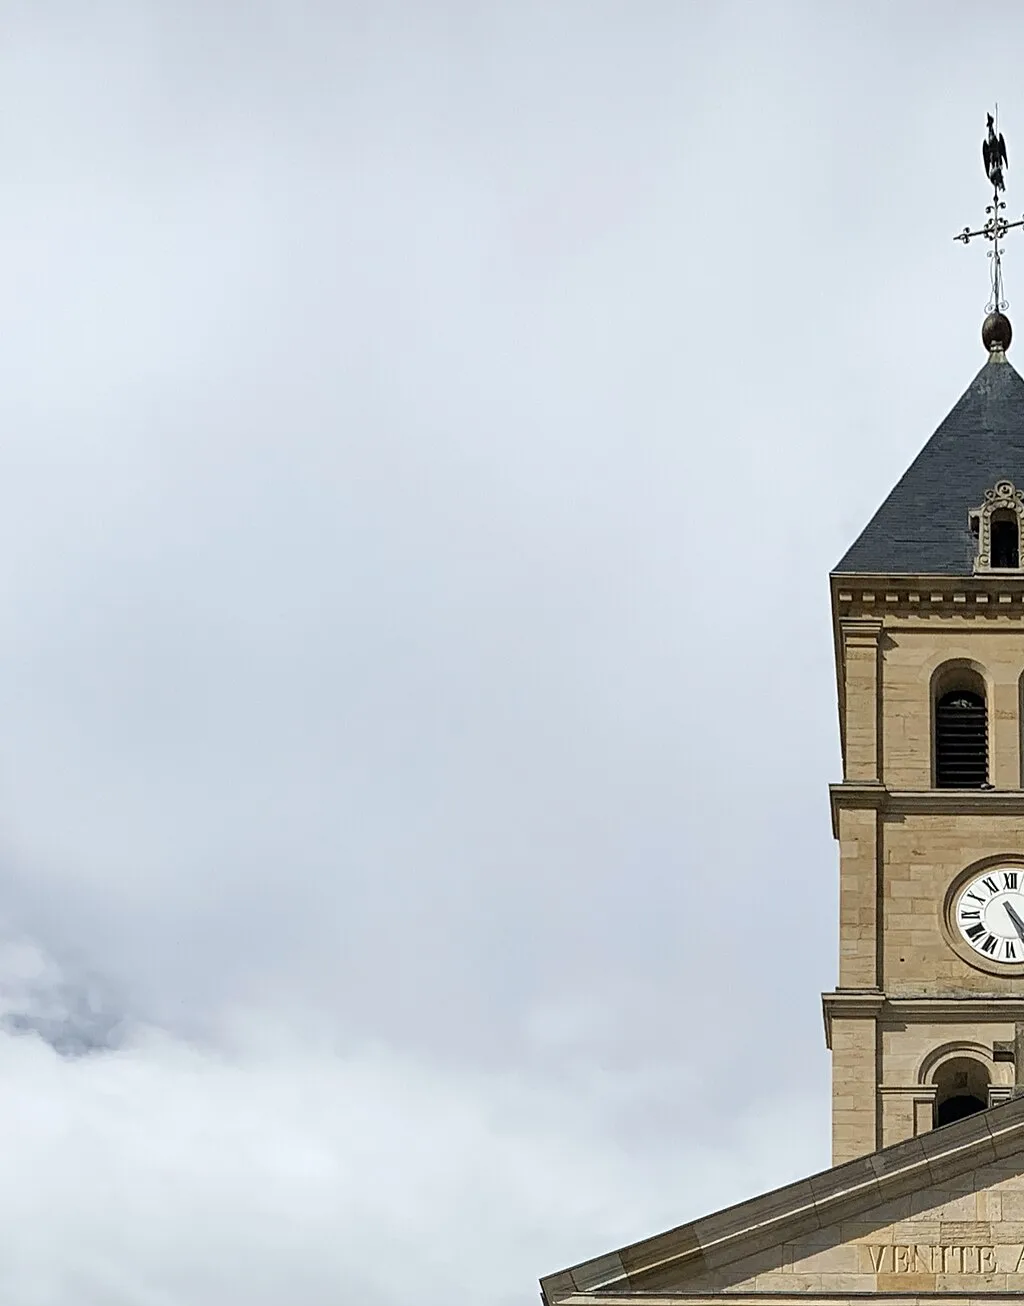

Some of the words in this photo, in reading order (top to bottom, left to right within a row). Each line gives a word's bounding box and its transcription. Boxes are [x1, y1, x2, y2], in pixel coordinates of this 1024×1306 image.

[982, 876, 999, 895] XI
[1003, 873, 1018, 890] XII
[967, 890, 986, 905] X
[961, 910, 980, 920] IX
[981, 935, 999, 955] VII
[1005, 941, 1016, 958] VI
[866, 1245, 999, 1274] VENITE
